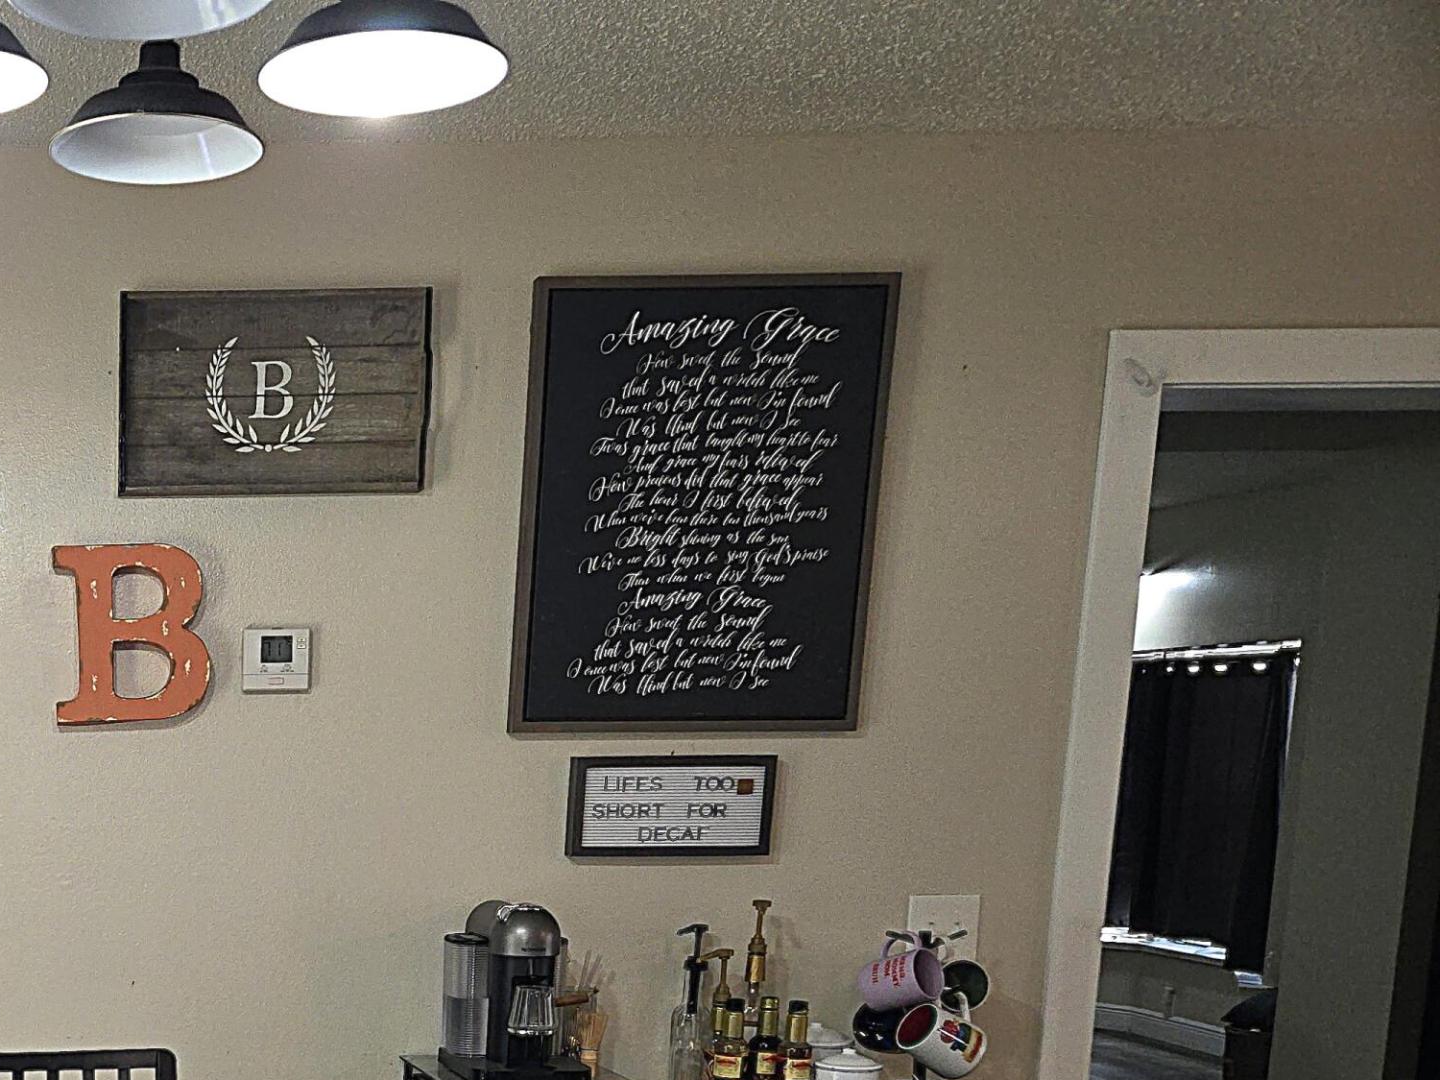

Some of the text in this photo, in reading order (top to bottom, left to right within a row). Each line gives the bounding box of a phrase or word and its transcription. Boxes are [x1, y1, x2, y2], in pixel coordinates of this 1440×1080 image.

[600, 307, 840, 354] Amazing Grace
[636, 351, 675, 375] How
[721, 347, 742, 367] the
[248, 360, 295, 419] B
[622, 377, 649, 399] that
[656, 364, 711, 397] saved
[709, 375, 716, 385] a
[769, 368, 800, 389] like
[800, 375, 819, 385] me
[600, 397, 615, 419] I
[642, 398, 669, 414] was
[672, 390, 701, 412] lost
[704, 386, 728, 407] but
[787, 381, 841, 417] found
[616, 410, 800, 438] Was blind but now I see
[628, 440, 671, 463] grace
[672, 433, 700, 453] that
[810, 429, 839, 452] fear
[662, 455, 697, 473] grace
[589, 472, 633, 502] How
[684, 467, 709, 490] did
[709, 470, 739, 488] that
[737, 469, 781, 491] grace
[618, 491, 645, 512] The
[649, 488, 678, 506] hour
[683, 490, 700, 508] I
[700, 489, 733, 512] first
[584, 510, 627, 532] When
[794, 507, 828, 523] years
[615, 526, 681, 551] Bright
[726, 531, 740, 544] as
[746, 527, 765, 544] the
[766, 533, 789, 546] sun
[643, 548, 667, 567] less
[671, 548, 699, 568] days
[704, 551, 718, 564] to
[725, 550, 749, 564] sing
[789, 548, 829, 566] praise
[717, 565, 747, 585] first
[617, 585, 767, 616] Amazing Grace
[51, 543, 211, 726] B
[605, 615, 642, 638] How
[687, 611, 708, 630] the
[714, 604, 773, 632] sound
[594, 639, 621, 661] that
[625, 628, 679, 659] saved
[676, 638, 683, 647] a
[736, 631, 765, 652] like
[769, 638, 788, 648] me
[567, 657, 582, 679] I
[609, 659, 636, 675] was
[640, 651, 669, 673] lost
[674, 648, 698, 668] but
[751, 644, 804, 677] found
[587, 670, 770, 696] Was blind but now I see
[603, 776, 735, 792] LIFES TOO
[592, 803, 728, 819] SHORT FOR
[638, 826, 710, 843] DECAF
